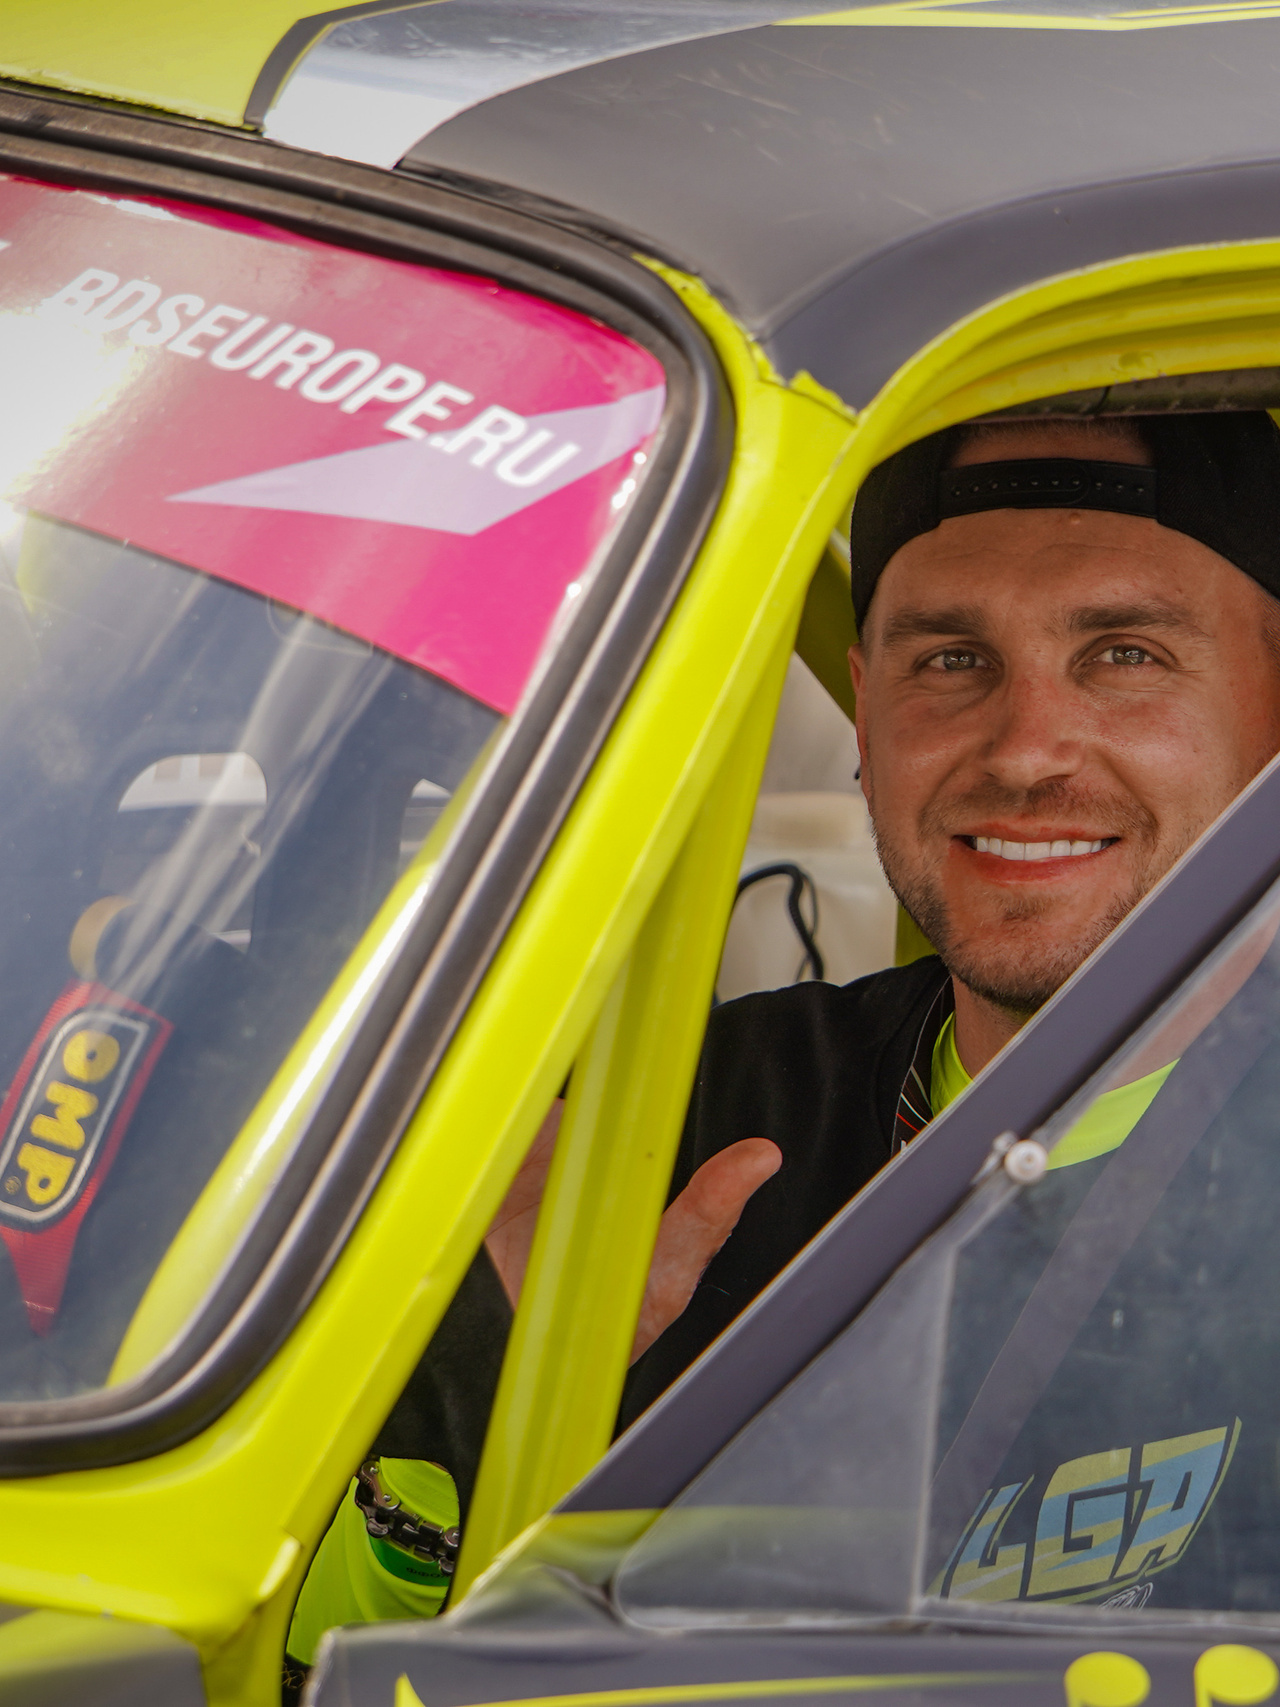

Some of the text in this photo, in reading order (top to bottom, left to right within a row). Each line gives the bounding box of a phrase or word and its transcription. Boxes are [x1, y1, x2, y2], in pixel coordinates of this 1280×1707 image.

[42, 267, 581, 488] BDSEUROPE.RU
[16, 1029, 120, 1205] OMP
[927, 1416, 1243, 1604] LGA
